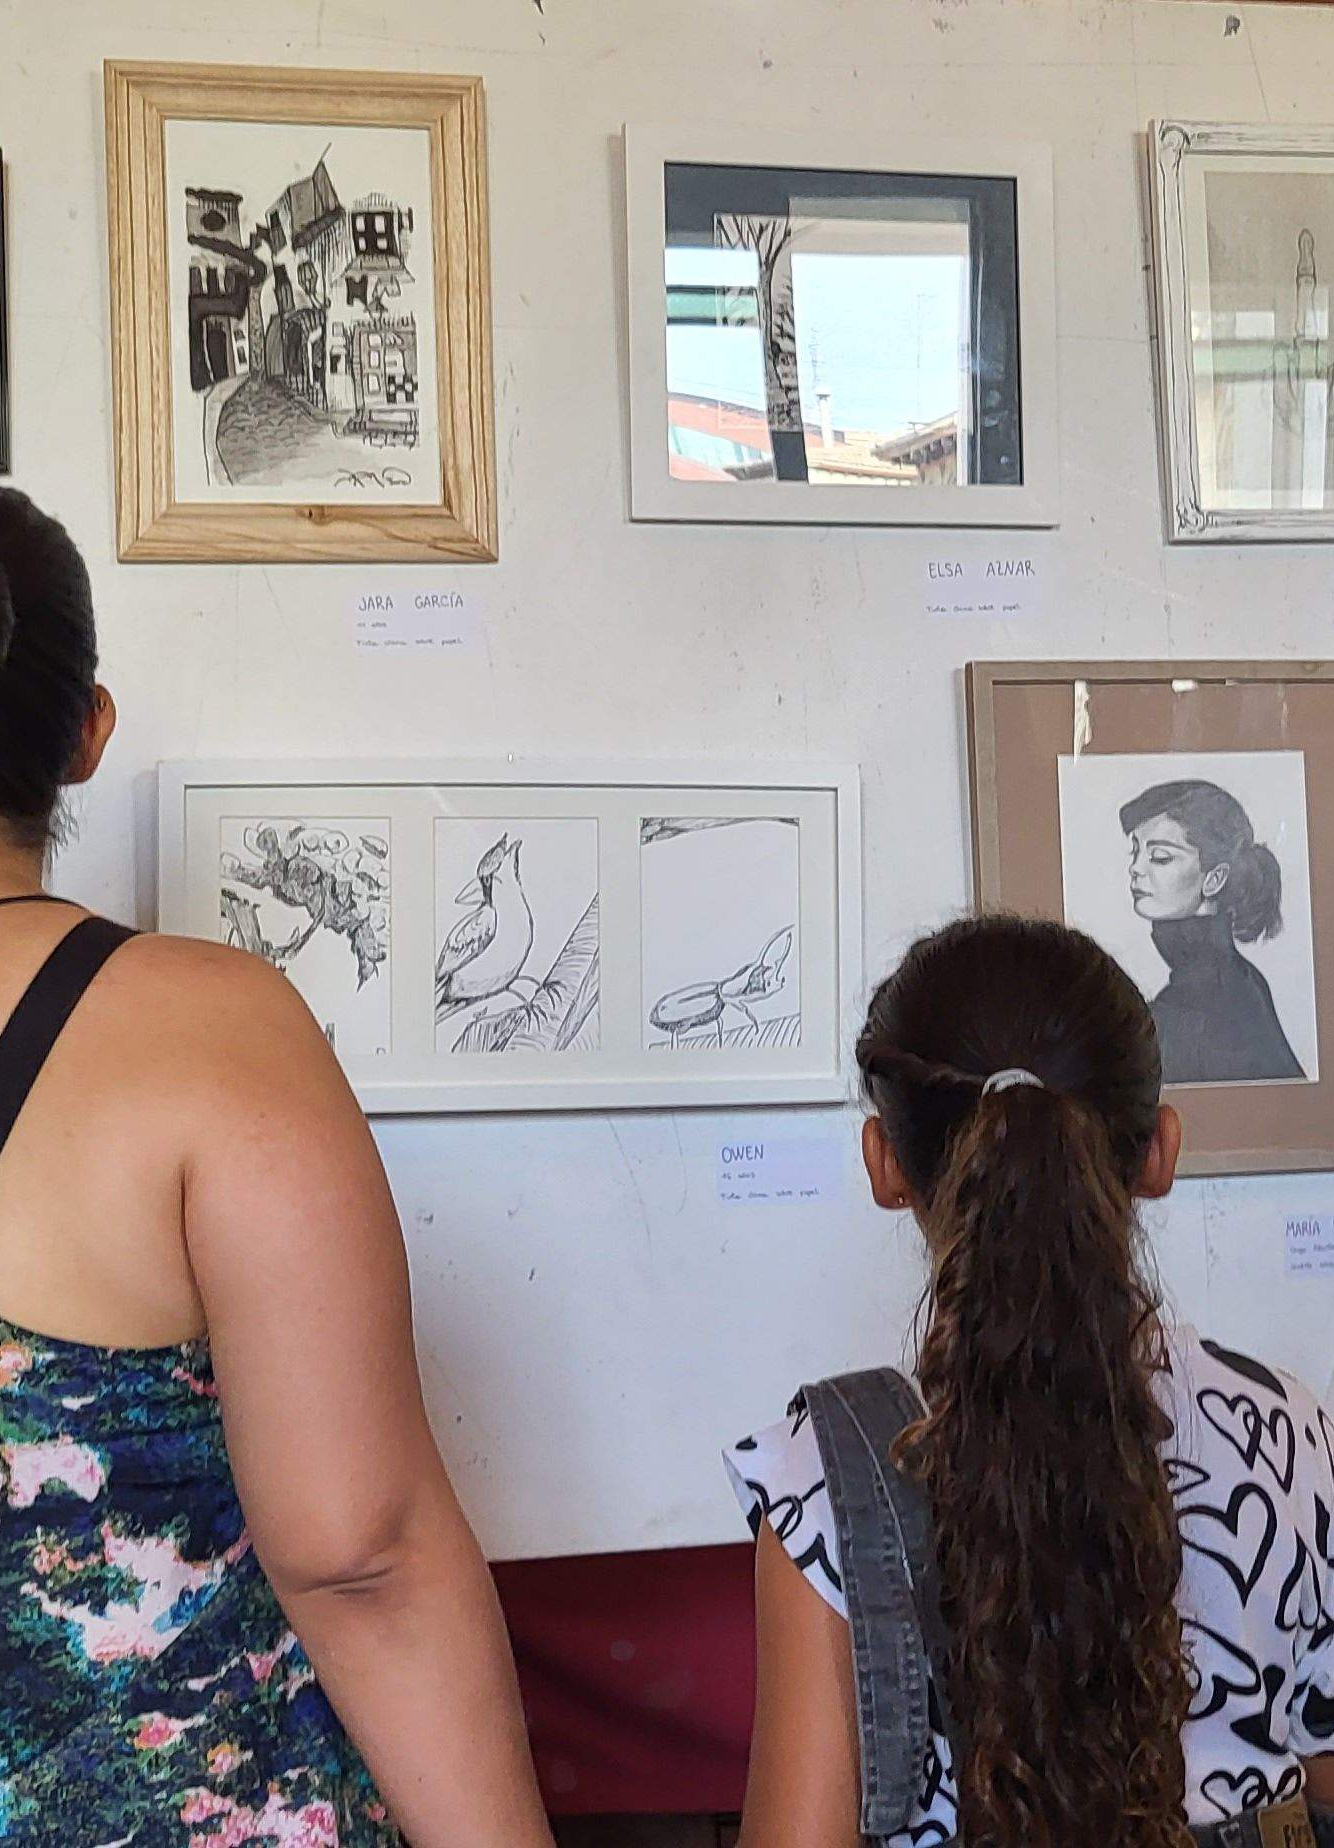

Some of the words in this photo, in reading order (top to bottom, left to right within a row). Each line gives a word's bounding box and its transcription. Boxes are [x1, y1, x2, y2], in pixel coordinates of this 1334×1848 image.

[928, 562, 964, 579] ELSA
[986, 559, 1036, 577] AZNAR
[358, 595, 395, 612] JARA
[414, 591, 464, 610] GARCÍA
[721, 1143, 764, 1164] OWEN
[1285, 1214, 1322, 1239] MARÍA
